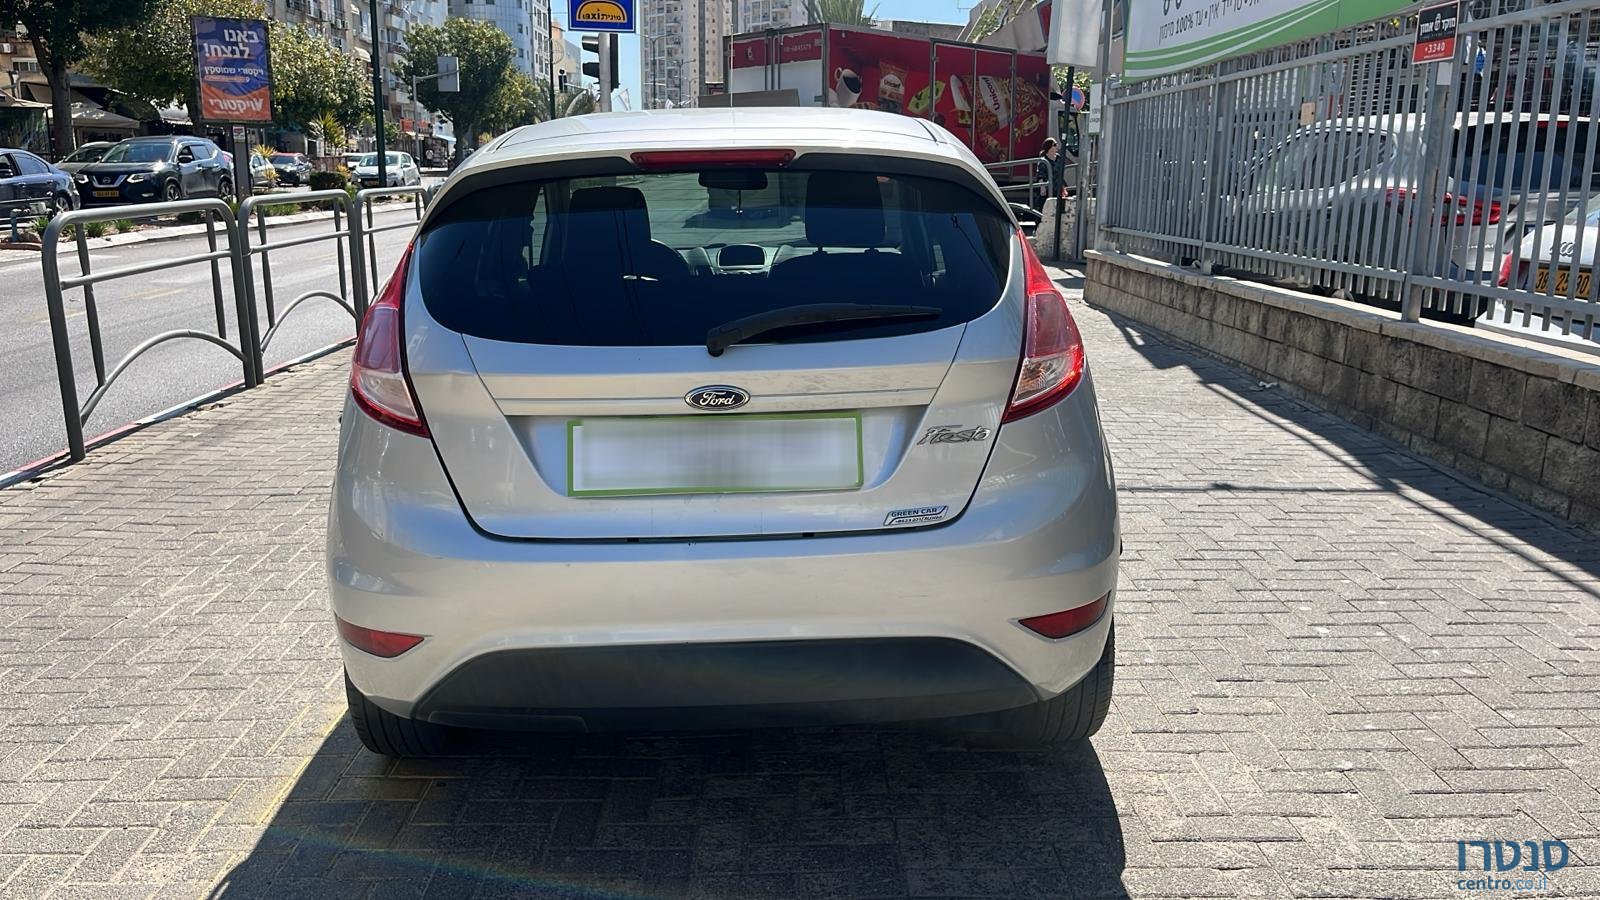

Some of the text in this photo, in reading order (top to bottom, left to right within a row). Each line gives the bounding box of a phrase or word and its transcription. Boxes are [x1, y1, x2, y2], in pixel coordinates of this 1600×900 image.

[1176, 13, 1194, 34] 100%
[224, 29, 260, 43] באנו
[203, 42, 250, 59] לנצח!
[700, 391, 735, 405] Ford
[917, 424, 991, 445] Fiesta
[891, 509, 918, 517] GREEN
